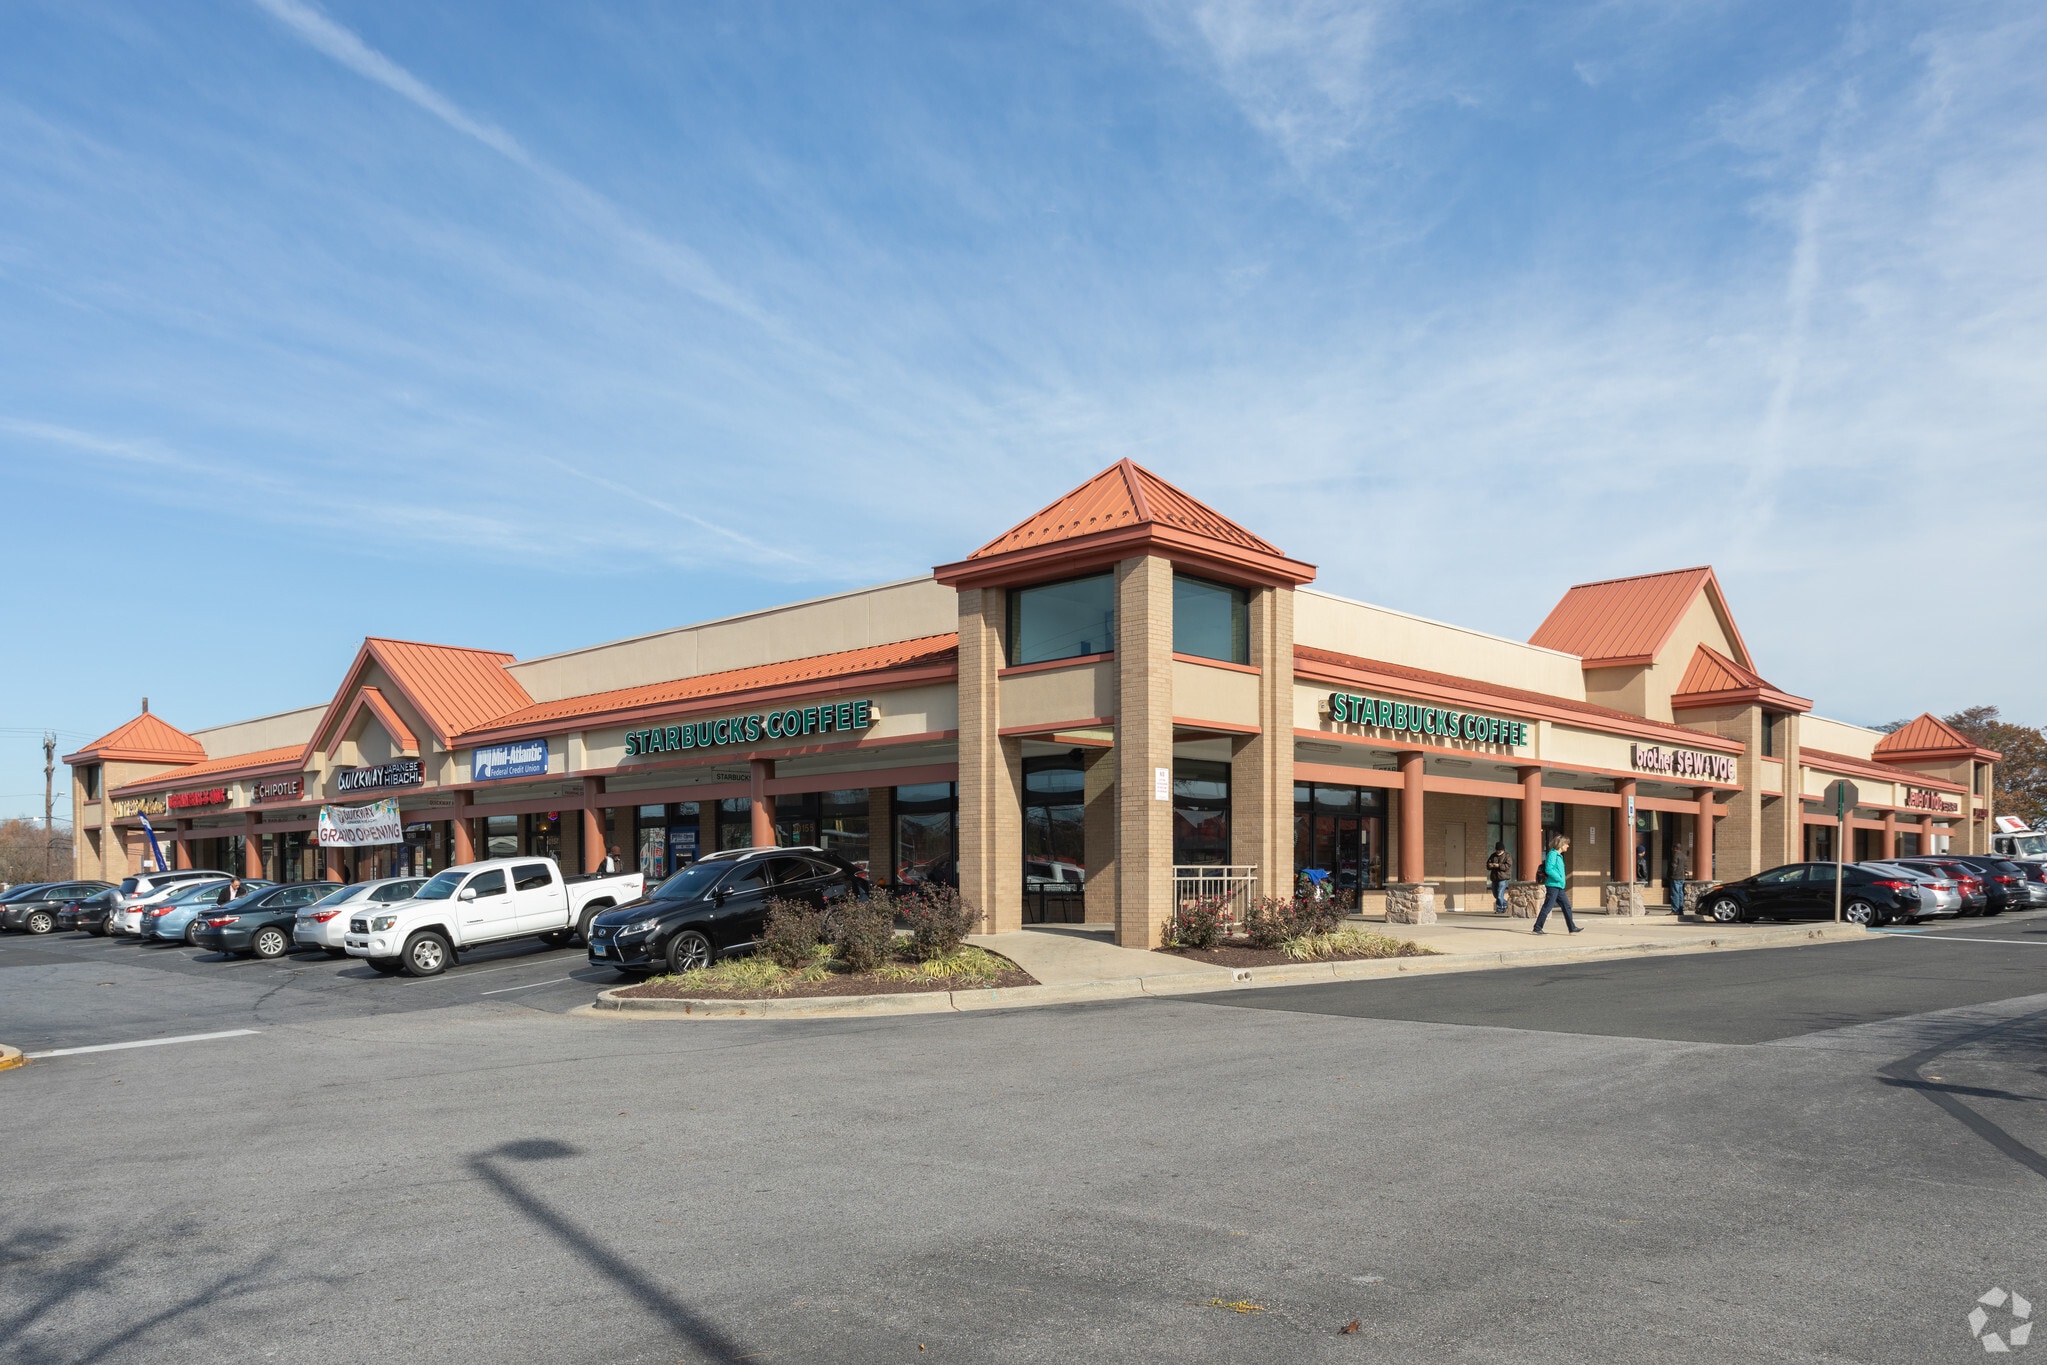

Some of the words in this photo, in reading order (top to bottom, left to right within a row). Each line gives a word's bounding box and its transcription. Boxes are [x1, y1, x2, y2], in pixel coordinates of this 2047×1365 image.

[624, 714, 761, 757] STARBUCKS
[765, 699, 869, 739] COFFEE
[1333, 692, 1460, 738] STARBUCKS
[1463, 713, 1528, 747] COFFEE
[491, 743, 542, 767] Mid-Atlantic
[1635, 742, 1674, 771] brother
[1677, 750, 1705, 775] sew
[1711, 755, 1736, 780] vac
[337, 766, 384, 791] QUICKWAY
[384, 761, 418, 775] JAPANESE
[384, 771, 418, 786] HIBACHI
[490, 766, 508, 777] Federal
[509, 765, 524, 775] Credit
[525, 764, 540, 773] Union
[259, 781, 297, 798] CHIPOTLE
[320, 828, 356, 843] GRAND
[355, 823, 400, 842] OPENING
